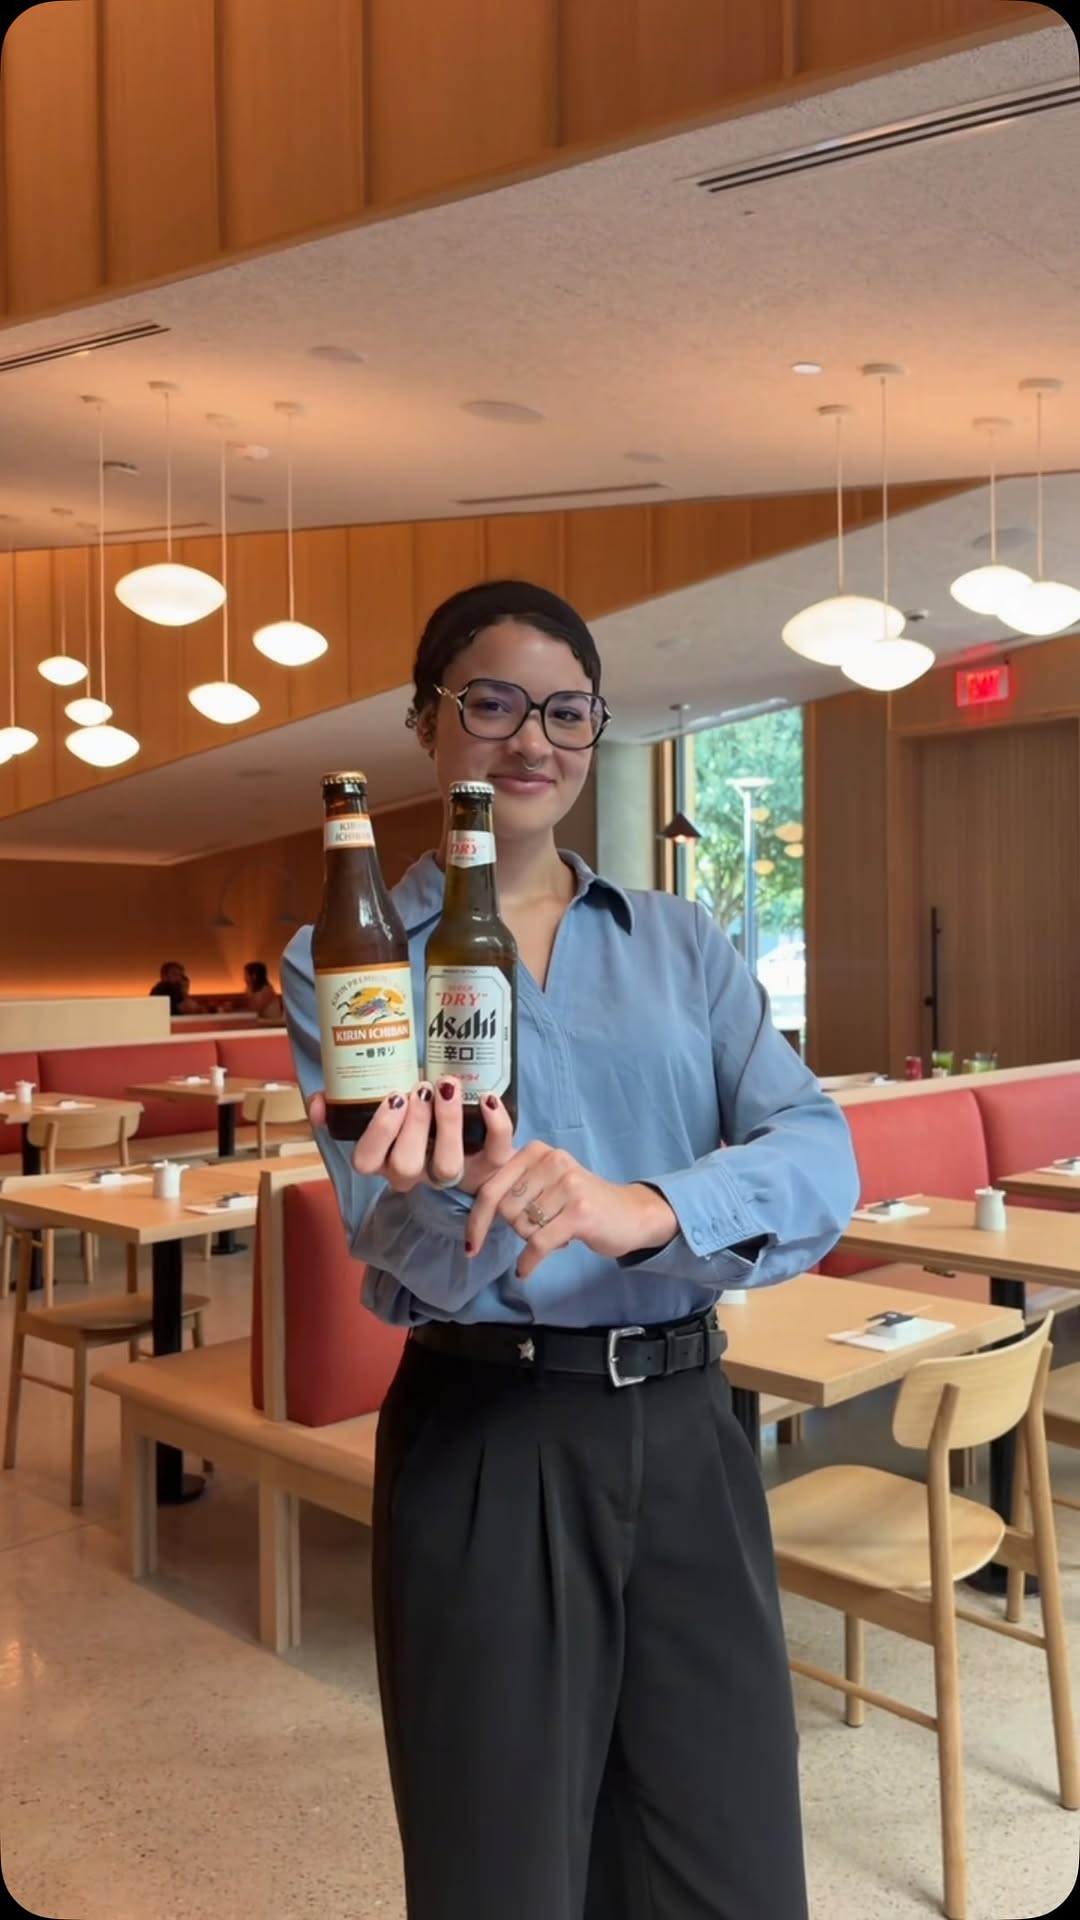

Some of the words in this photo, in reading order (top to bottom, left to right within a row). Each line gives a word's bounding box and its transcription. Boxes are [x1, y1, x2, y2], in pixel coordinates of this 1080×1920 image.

[428, 1007, 497, 1040] Asahi
[335, 1028, 367, 1042] KIRIN
[444, 1046, 474, 1061] 辛口
